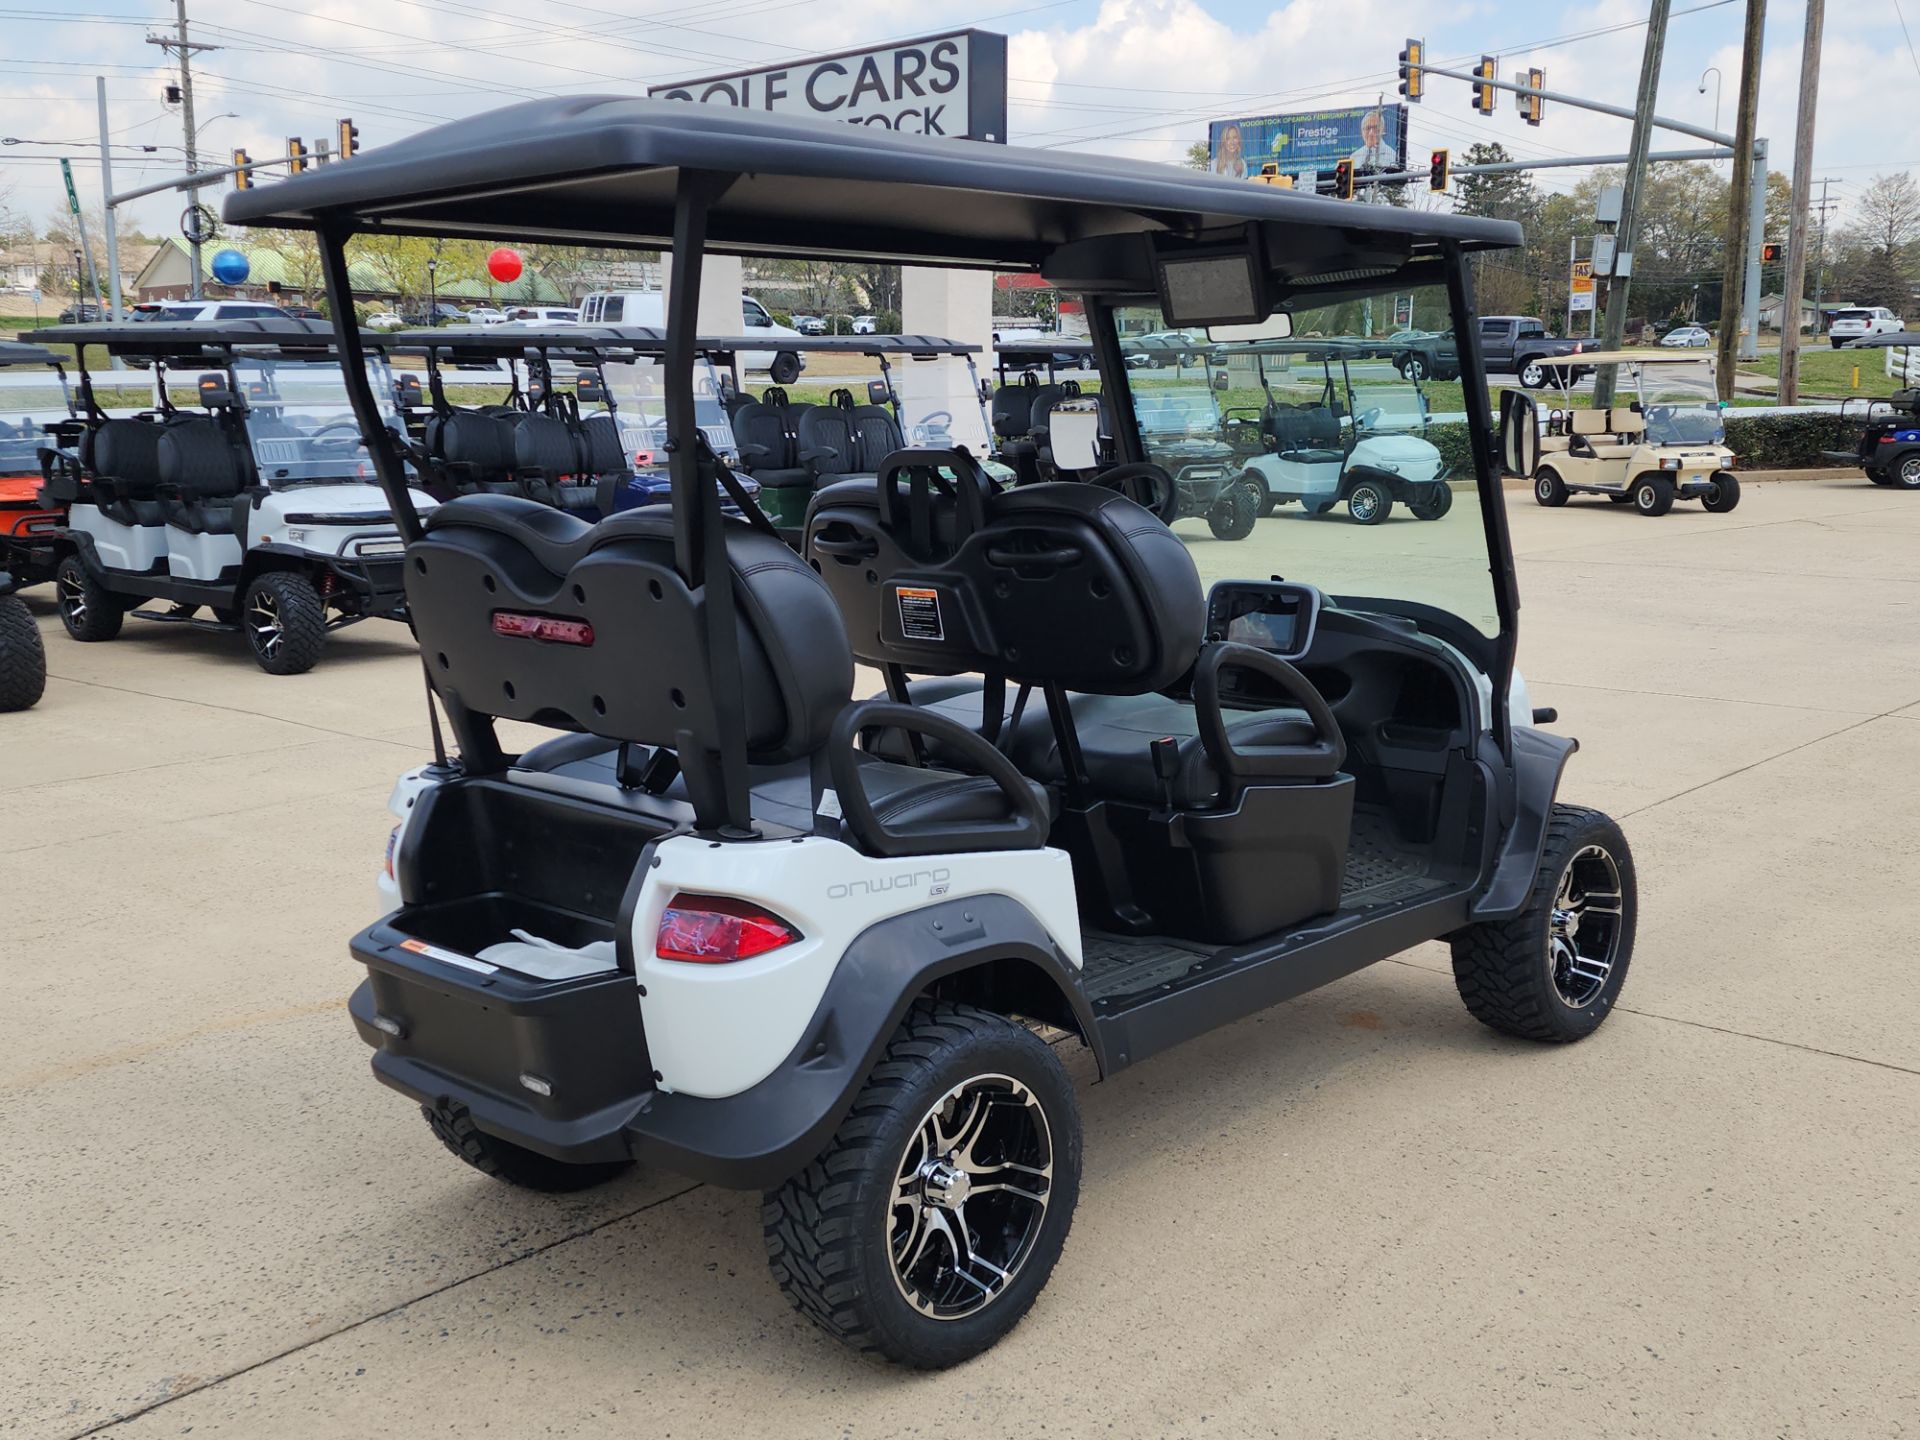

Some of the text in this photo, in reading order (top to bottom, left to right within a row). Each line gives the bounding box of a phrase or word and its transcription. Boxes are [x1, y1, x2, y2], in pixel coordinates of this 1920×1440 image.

[664, 41, 960, 112] OLF CARS
[1297, 126, 1339, 139] Prestige
[826, 867, 950, 899] onward
[929, 885, 950, 896] LSV
